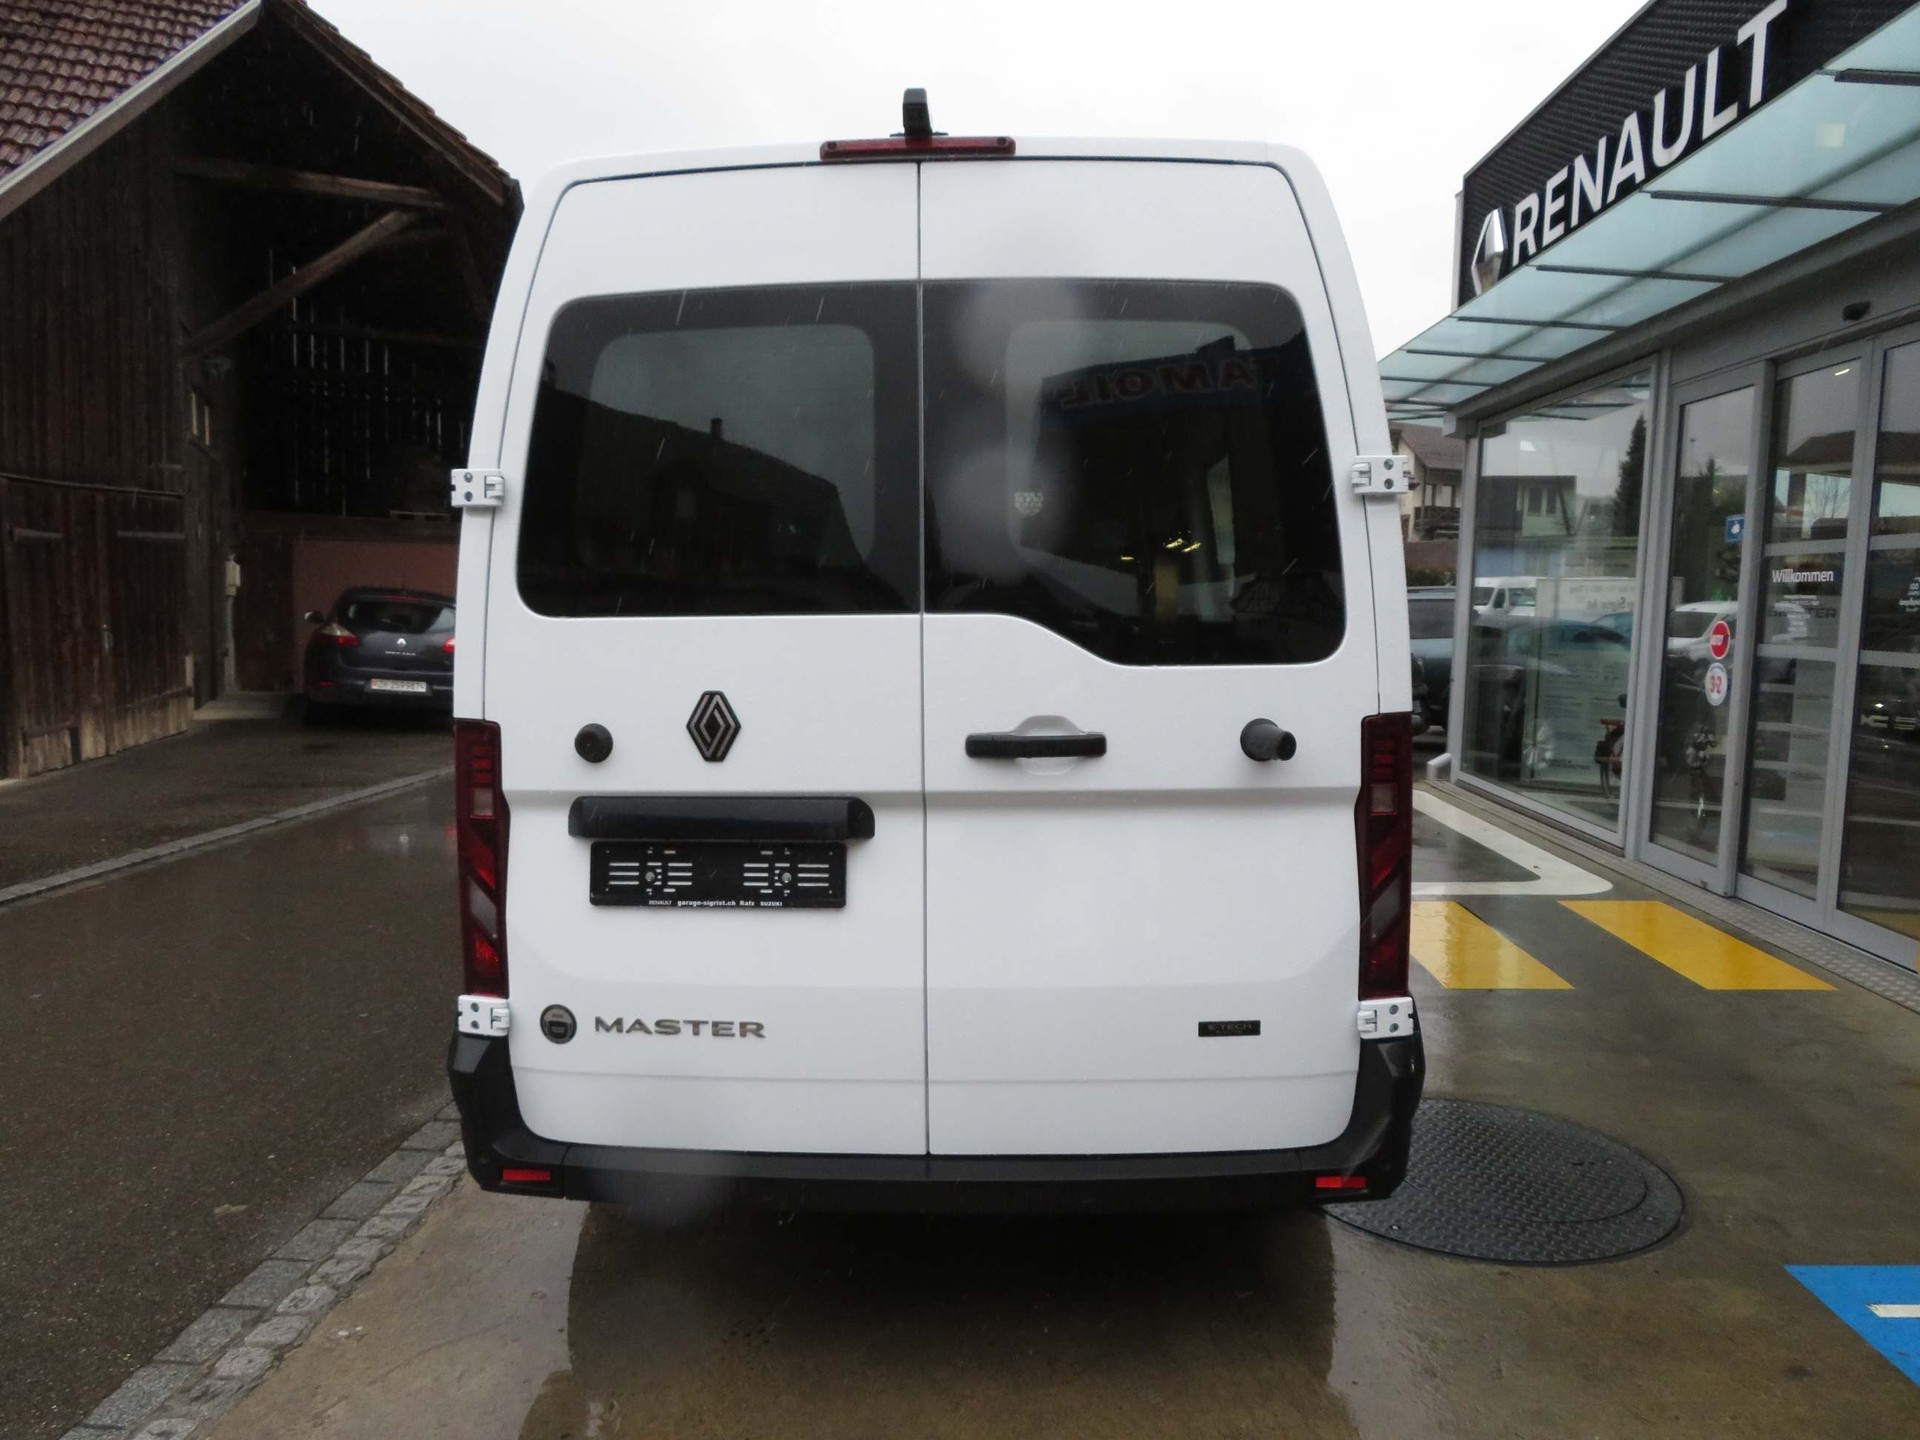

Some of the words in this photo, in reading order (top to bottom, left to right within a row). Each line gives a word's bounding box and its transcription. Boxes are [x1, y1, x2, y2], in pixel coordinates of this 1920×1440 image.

[1512, 0, 1788, 267] RENAULT
[1771, 569, 1834, 583] Willkommen
[594, 1016, 766, 1038] MASTER
